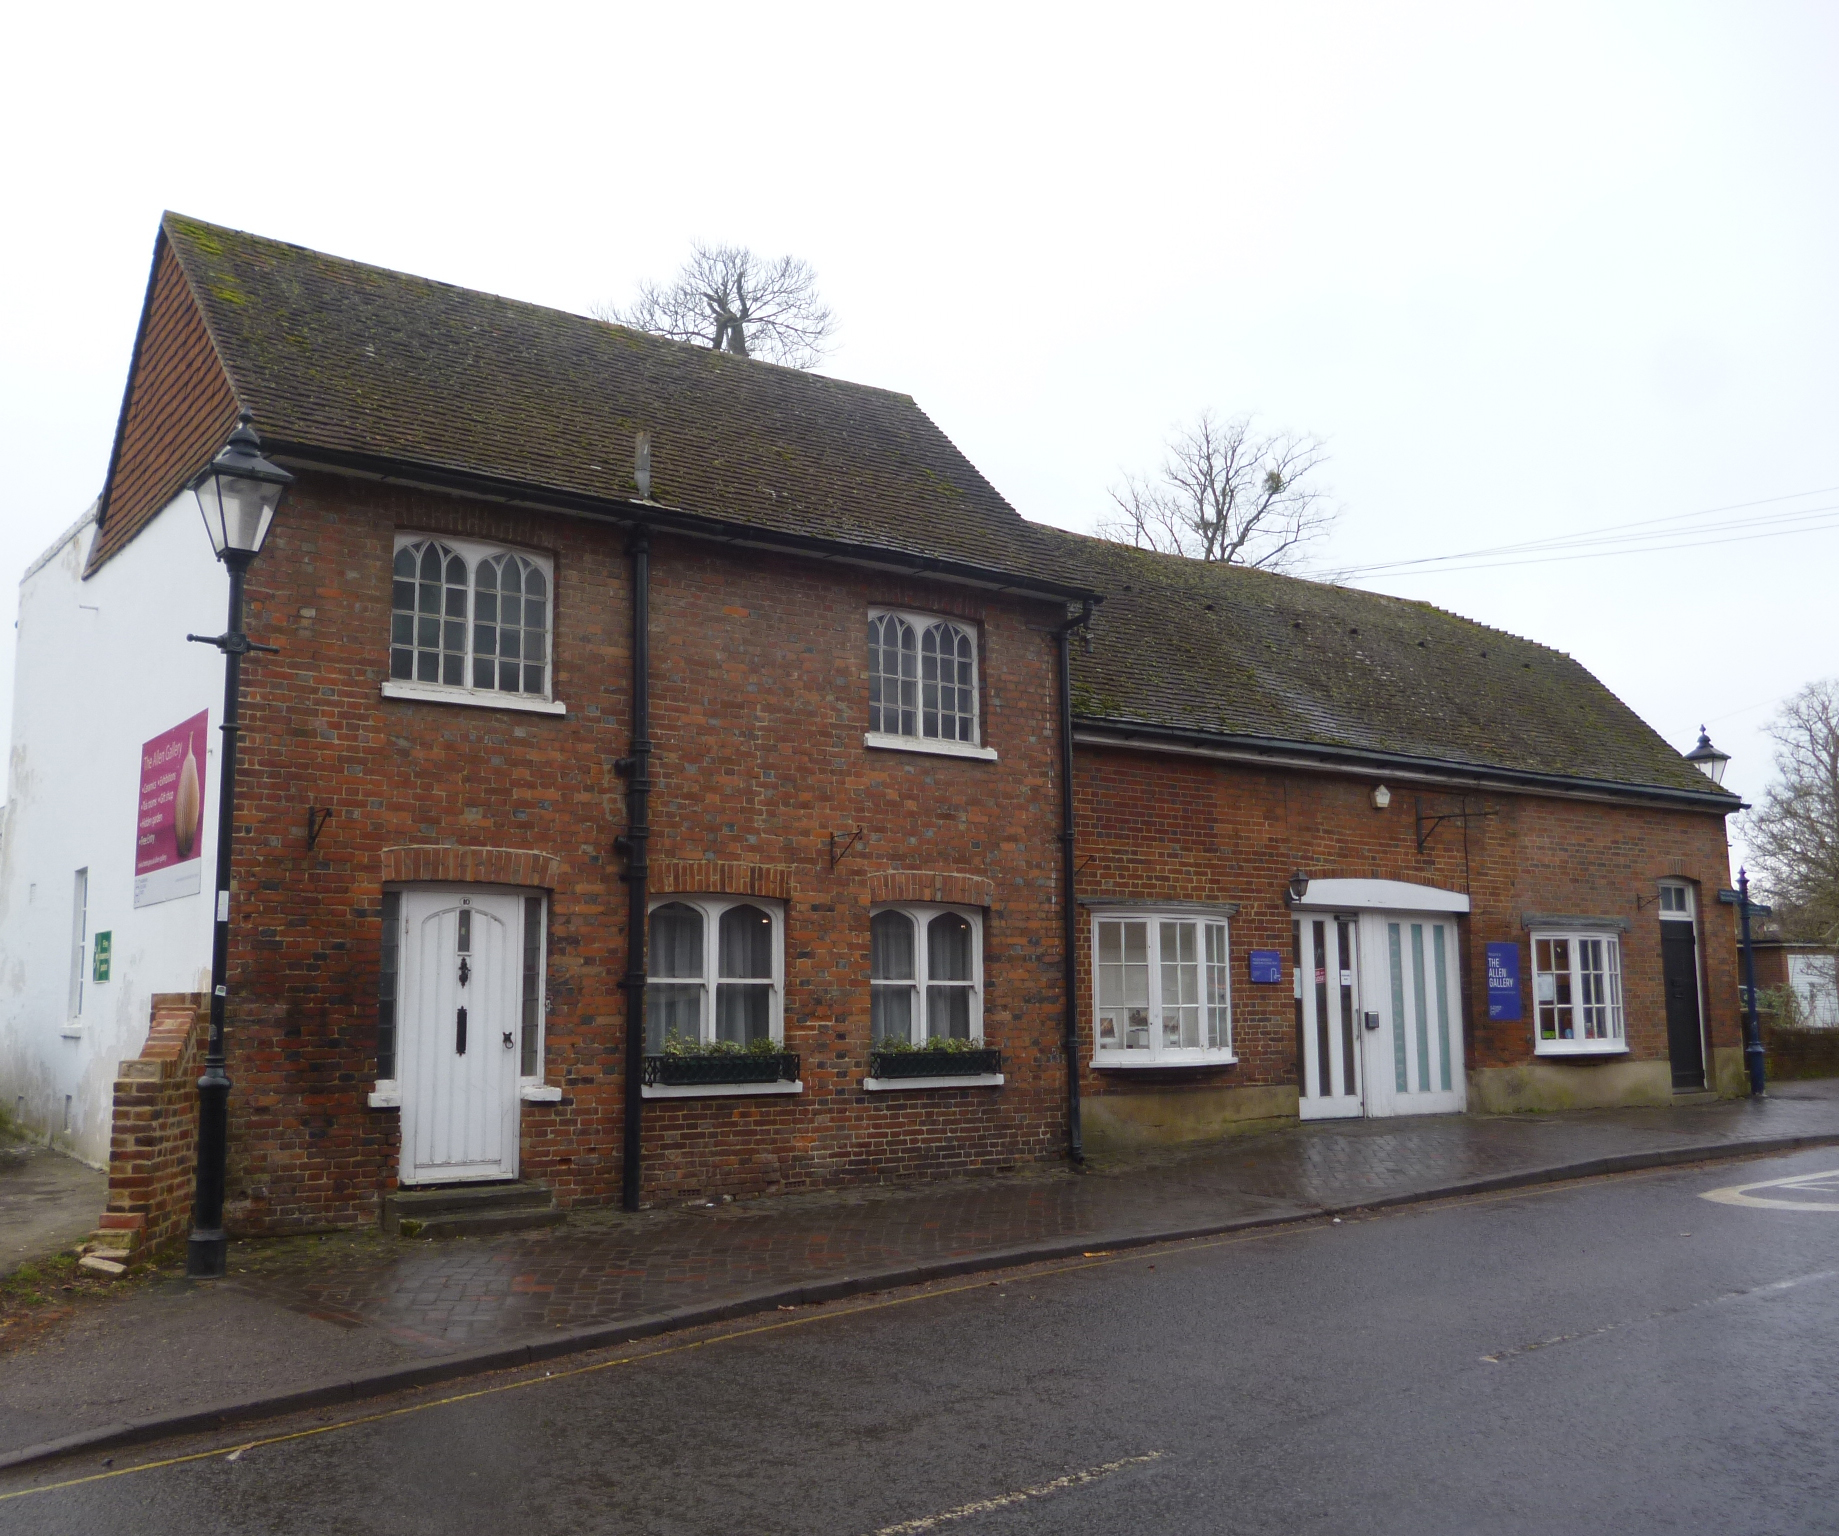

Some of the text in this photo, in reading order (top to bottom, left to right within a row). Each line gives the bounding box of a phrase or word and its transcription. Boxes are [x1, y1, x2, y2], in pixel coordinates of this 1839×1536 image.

[144, 741, 183, 769] The Allen Gallery
[1488, 958, 1500, 968] THE
[1488, 968, 1507, 978] ALLEN
[1488, 978, 1514, 988] GALLERY
[1389, 932, 1406, 1087] ALLEN GALLERY
